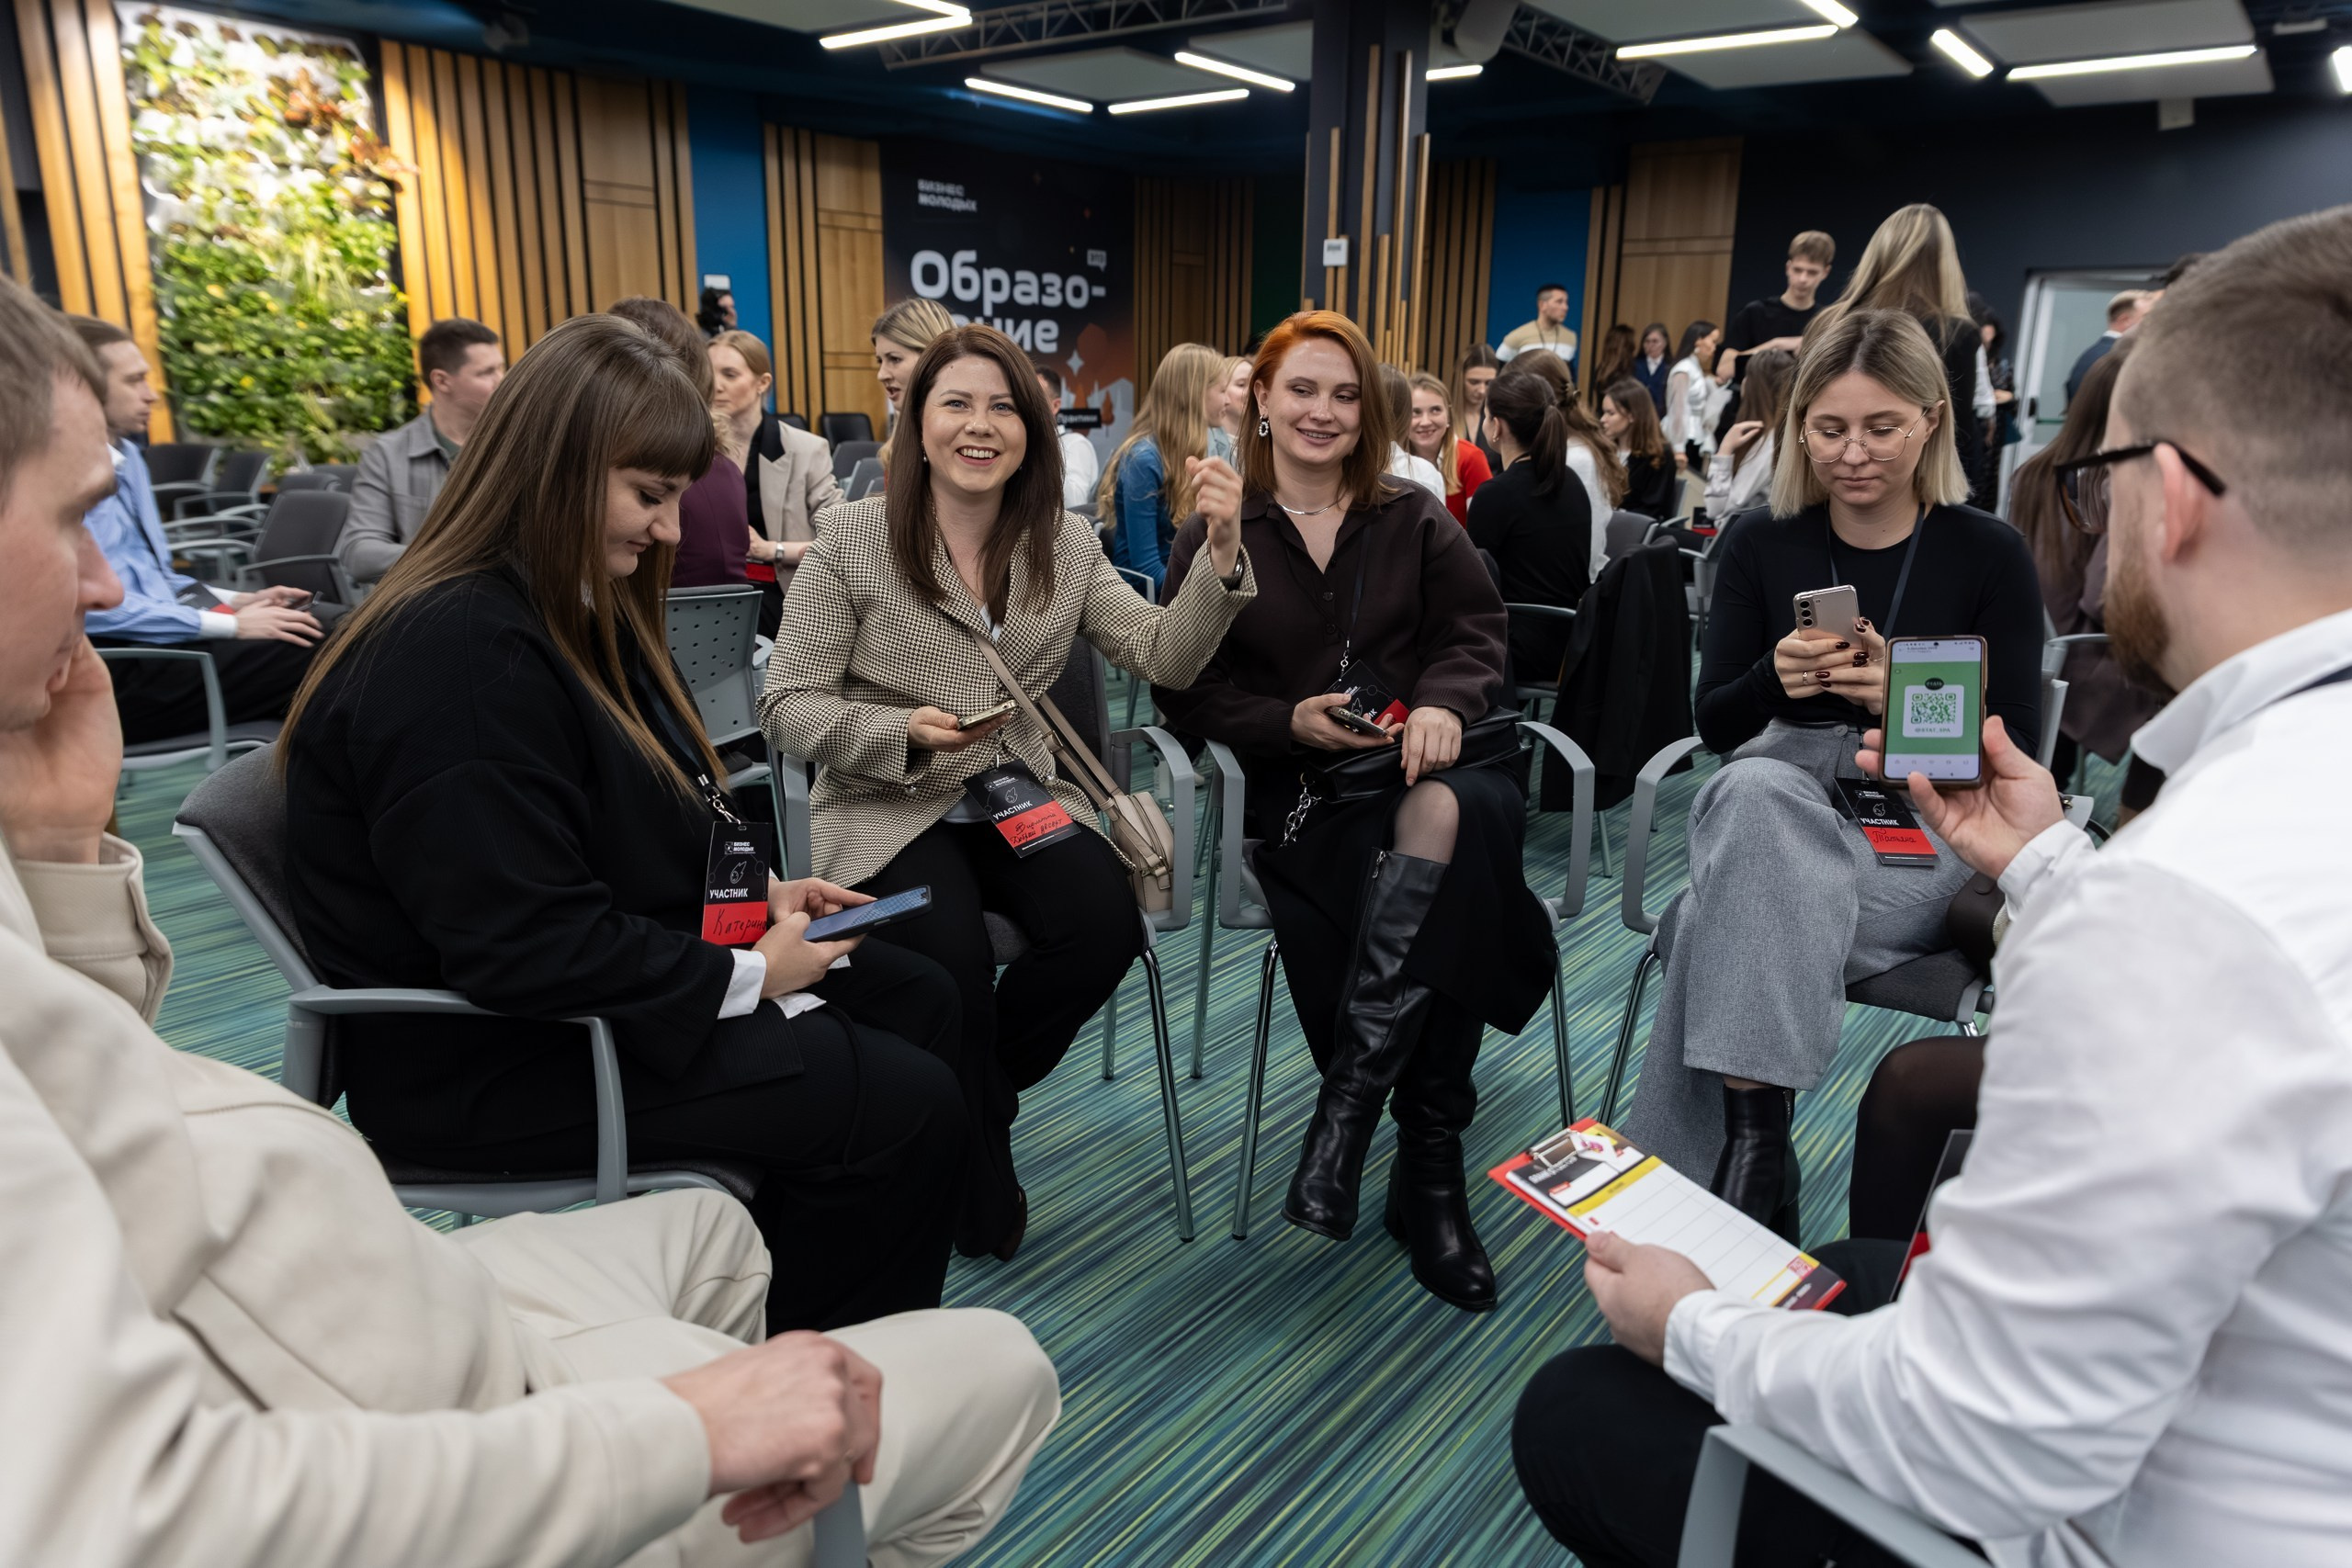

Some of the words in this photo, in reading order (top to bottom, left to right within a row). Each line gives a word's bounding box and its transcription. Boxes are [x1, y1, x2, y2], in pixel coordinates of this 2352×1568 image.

[910, 250, 1106, 317] Образо-
[992, 800, 1034, 820] УЧАСТНИК
[1860, 818, 1900, 826] УЧАСТНИК
[709, 888, 749, 899] УЧАСТНИК
